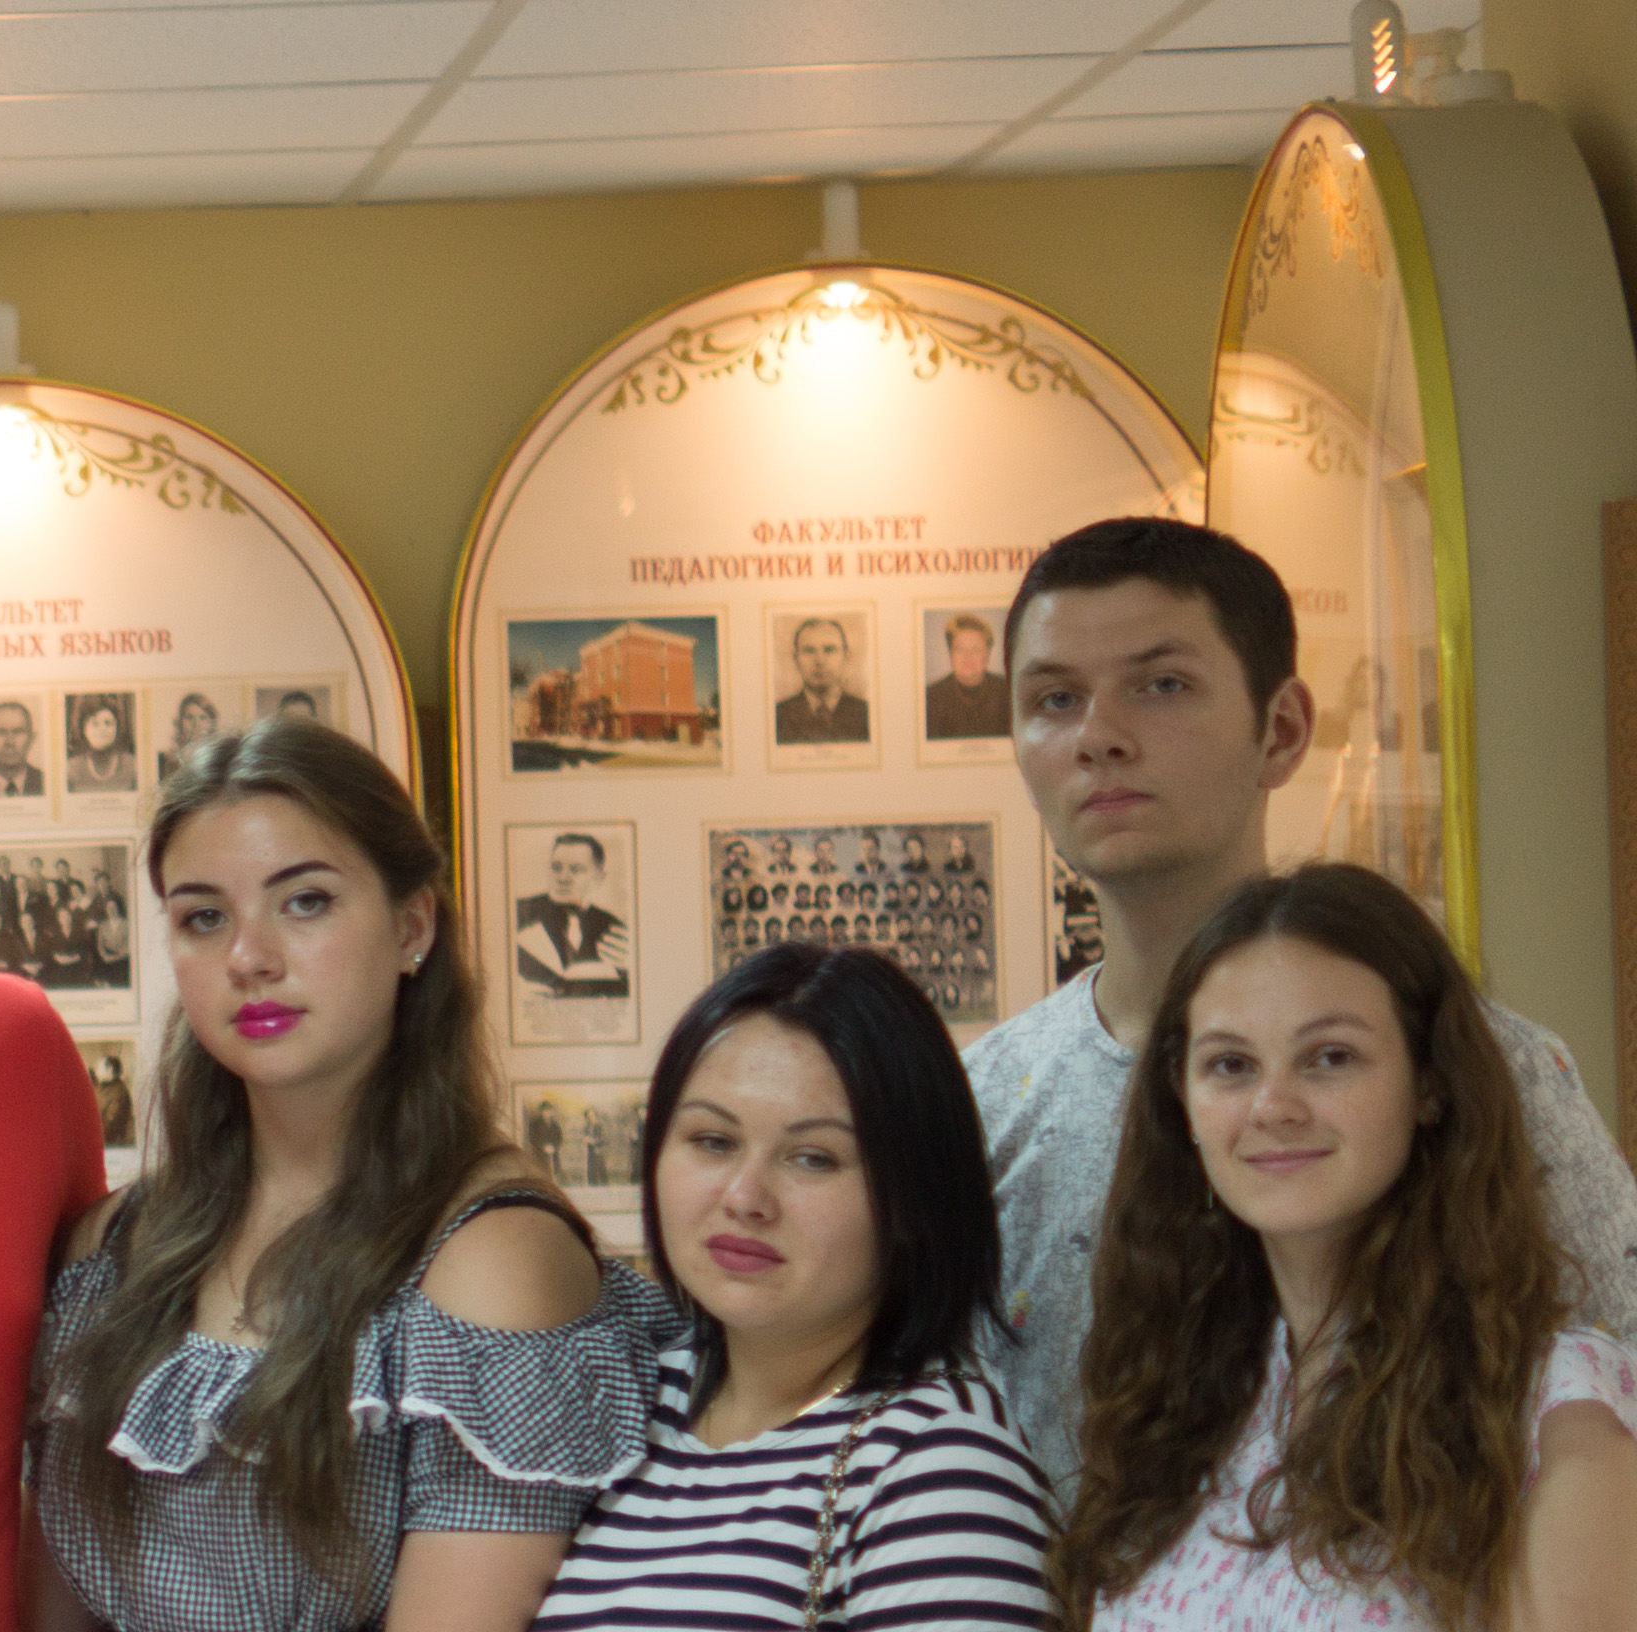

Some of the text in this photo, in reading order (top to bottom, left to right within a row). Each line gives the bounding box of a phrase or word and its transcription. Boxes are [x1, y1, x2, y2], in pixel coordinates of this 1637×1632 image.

[752, 516, 927, 546] ФАКУЛЬТЕТ
[630, 553, 814, 586] ПЕДАГОГИКИ
[826, 553, 844, 576] И
[59, 629, 173, 658] ЯЗЫКОВ
